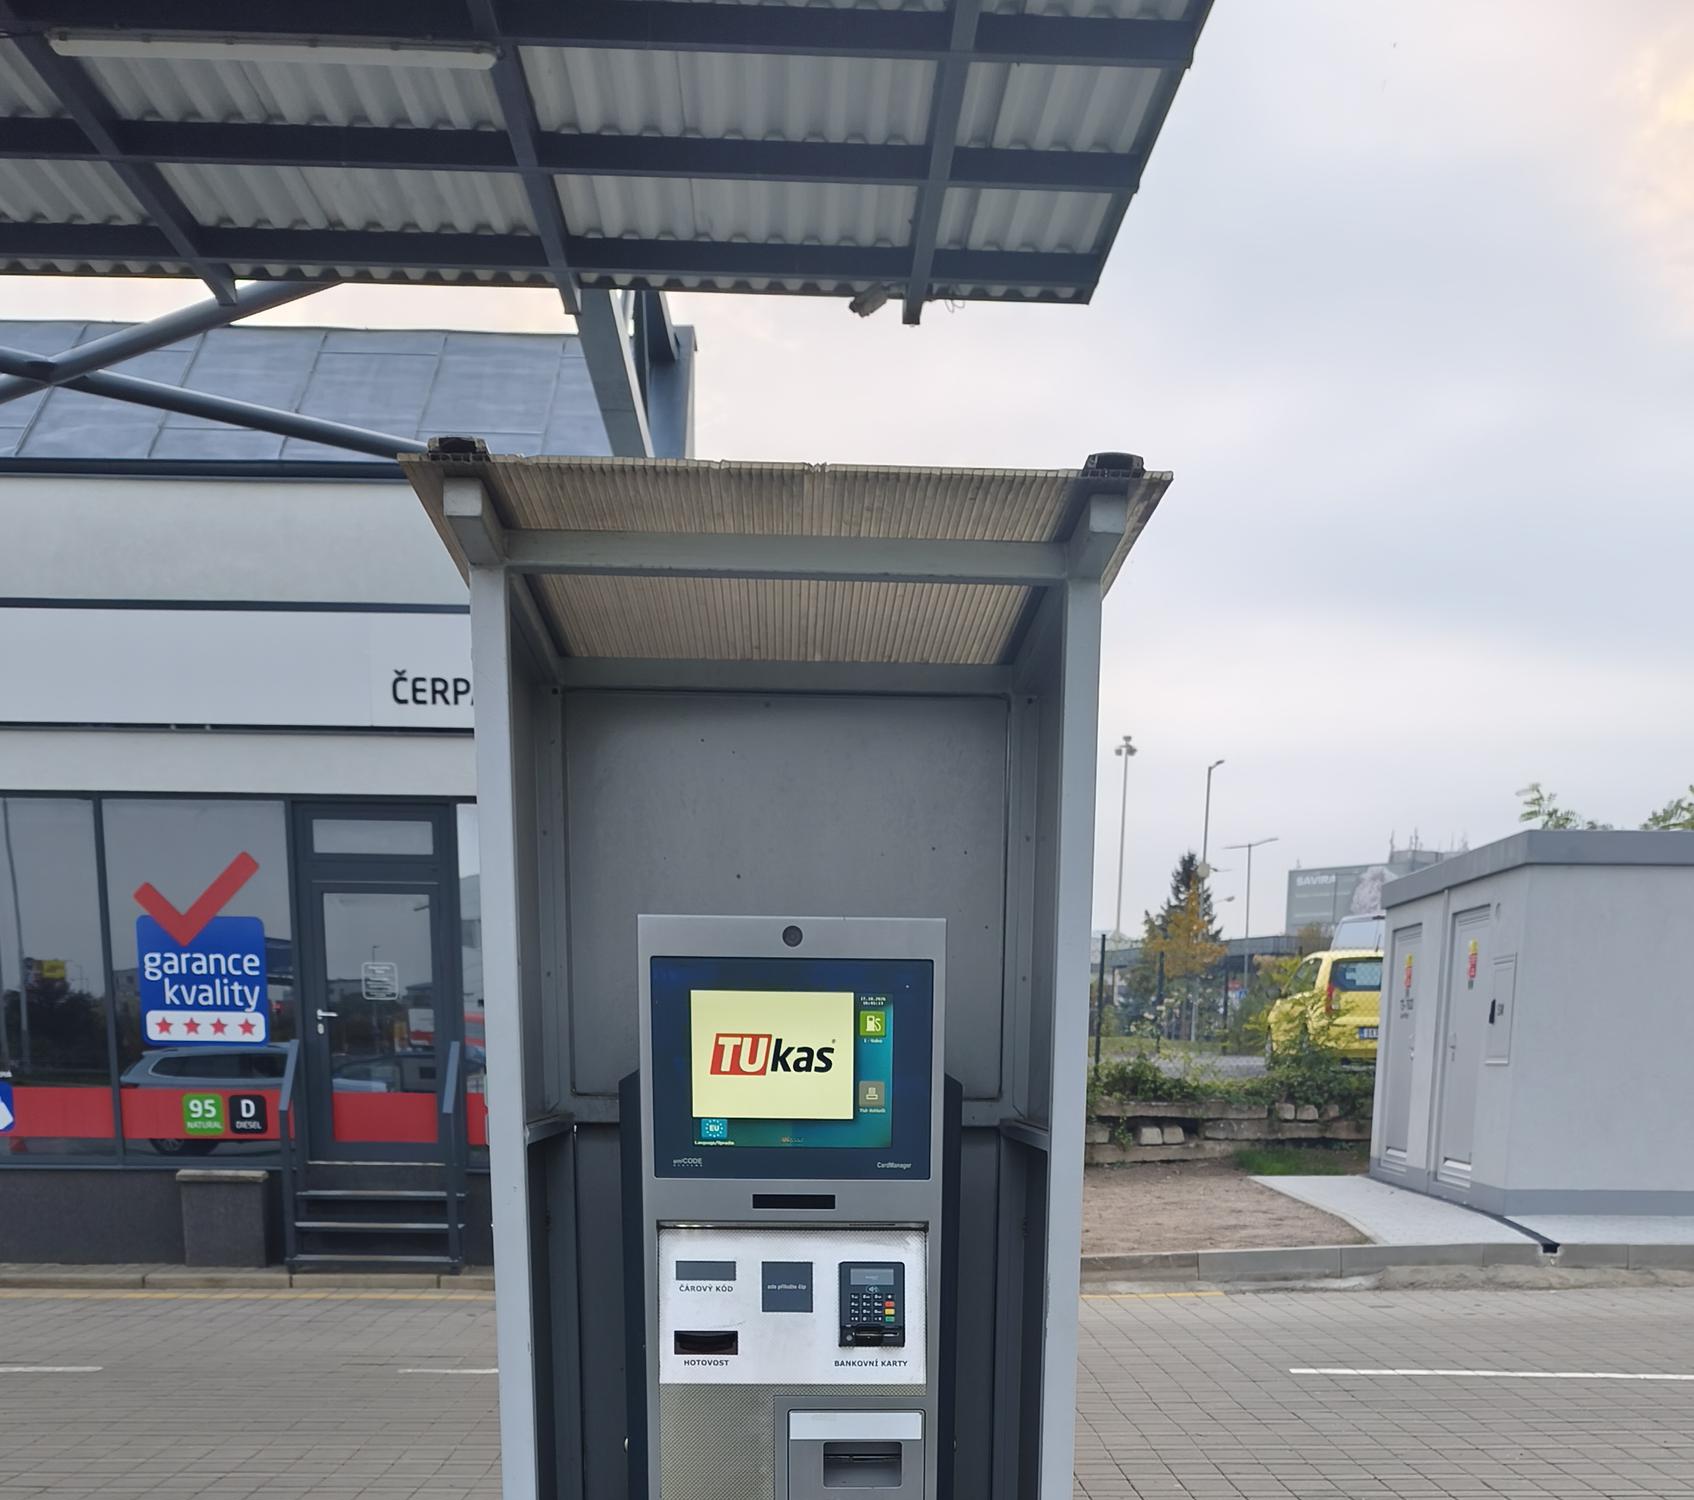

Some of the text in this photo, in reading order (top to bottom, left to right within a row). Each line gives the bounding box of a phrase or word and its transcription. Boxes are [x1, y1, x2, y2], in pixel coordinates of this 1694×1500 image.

[392, 669, 474, 706] ČERP
[143, 952, 260, 981] garance
[164, 977, 260, 1012] kvality
[712, 1034, 834, 1074] TUkas
[189, 1098, 216, 1118] 95
[240, 1098, 256, 1118] D
[185, 1121, 222, 1129] NATURAL
[235, 1121, 262, 1129] DIESEL
[709, 1124, 720, 1132] EU
[679, 1283, 734, 1292] ČÁROVÝ KÓD
[683, 1359, 730, 1367] HOTOVOST
[834, 1358, 878, 1367] BANKOVNÍ
